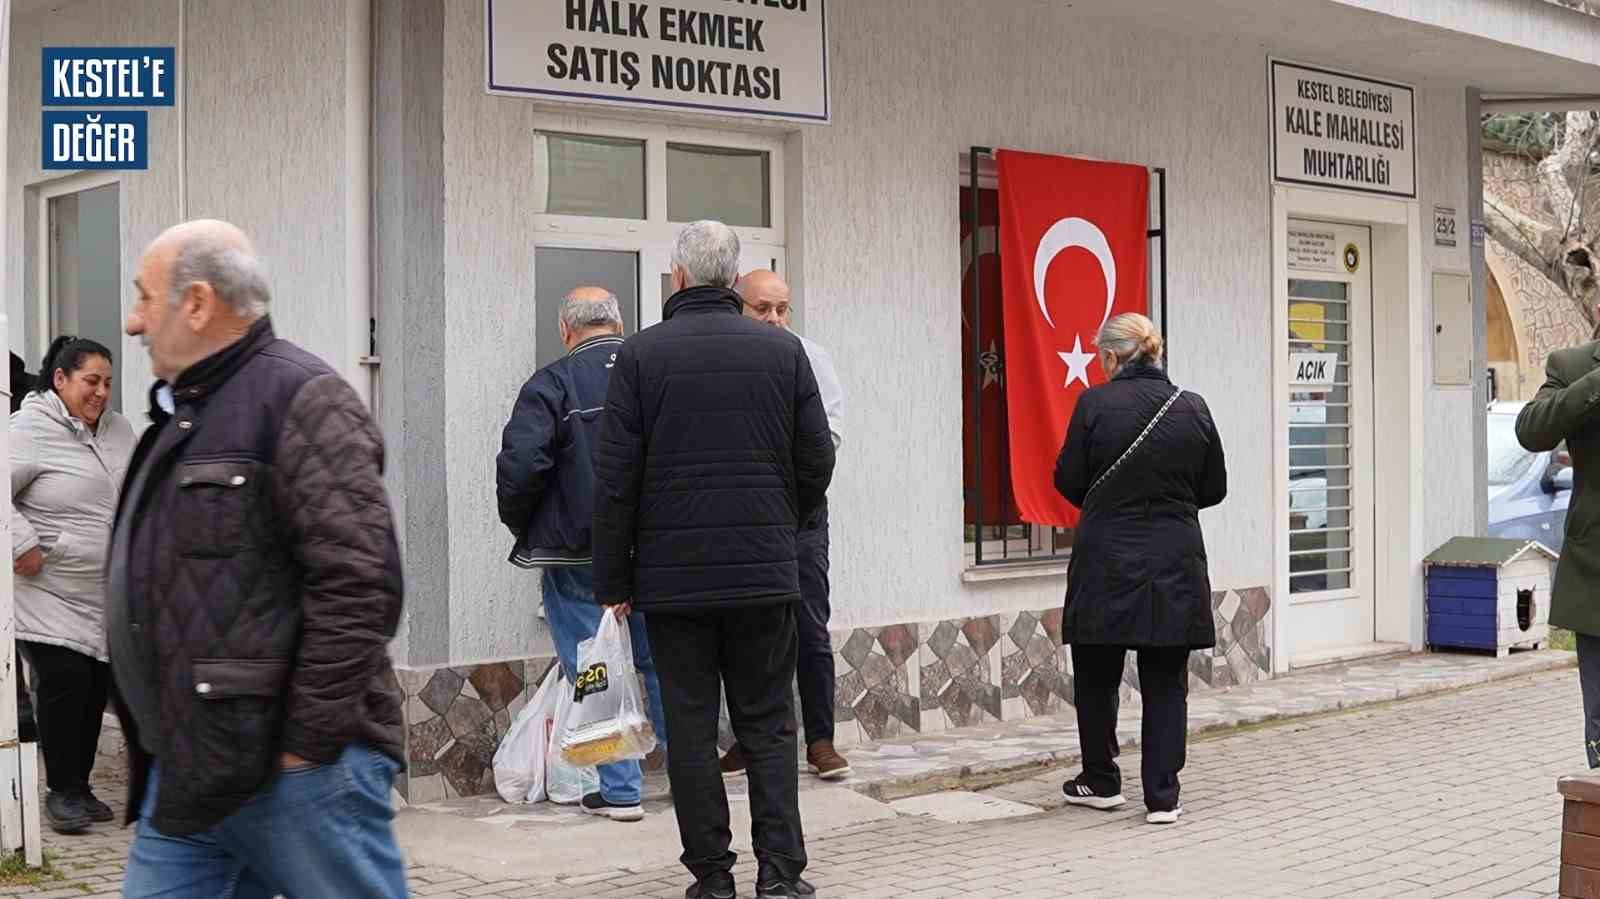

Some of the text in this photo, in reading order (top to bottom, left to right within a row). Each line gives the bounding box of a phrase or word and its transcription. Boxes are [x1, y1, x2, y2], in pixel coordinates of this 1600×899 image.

[566, 0, 765, 52] HALK EKMEK
[546, 43, 781, 100] SATIŞ NOKTASI
[1297, 79, 1393, 114] KESTEL BELEDİYESİ
[1285, 105, 1404, 150] KALE MAHALLESİ
[1303, 148, 1390, 185] MUHTARLIĞI
[1436, 216, 1456, 235] 25/2
